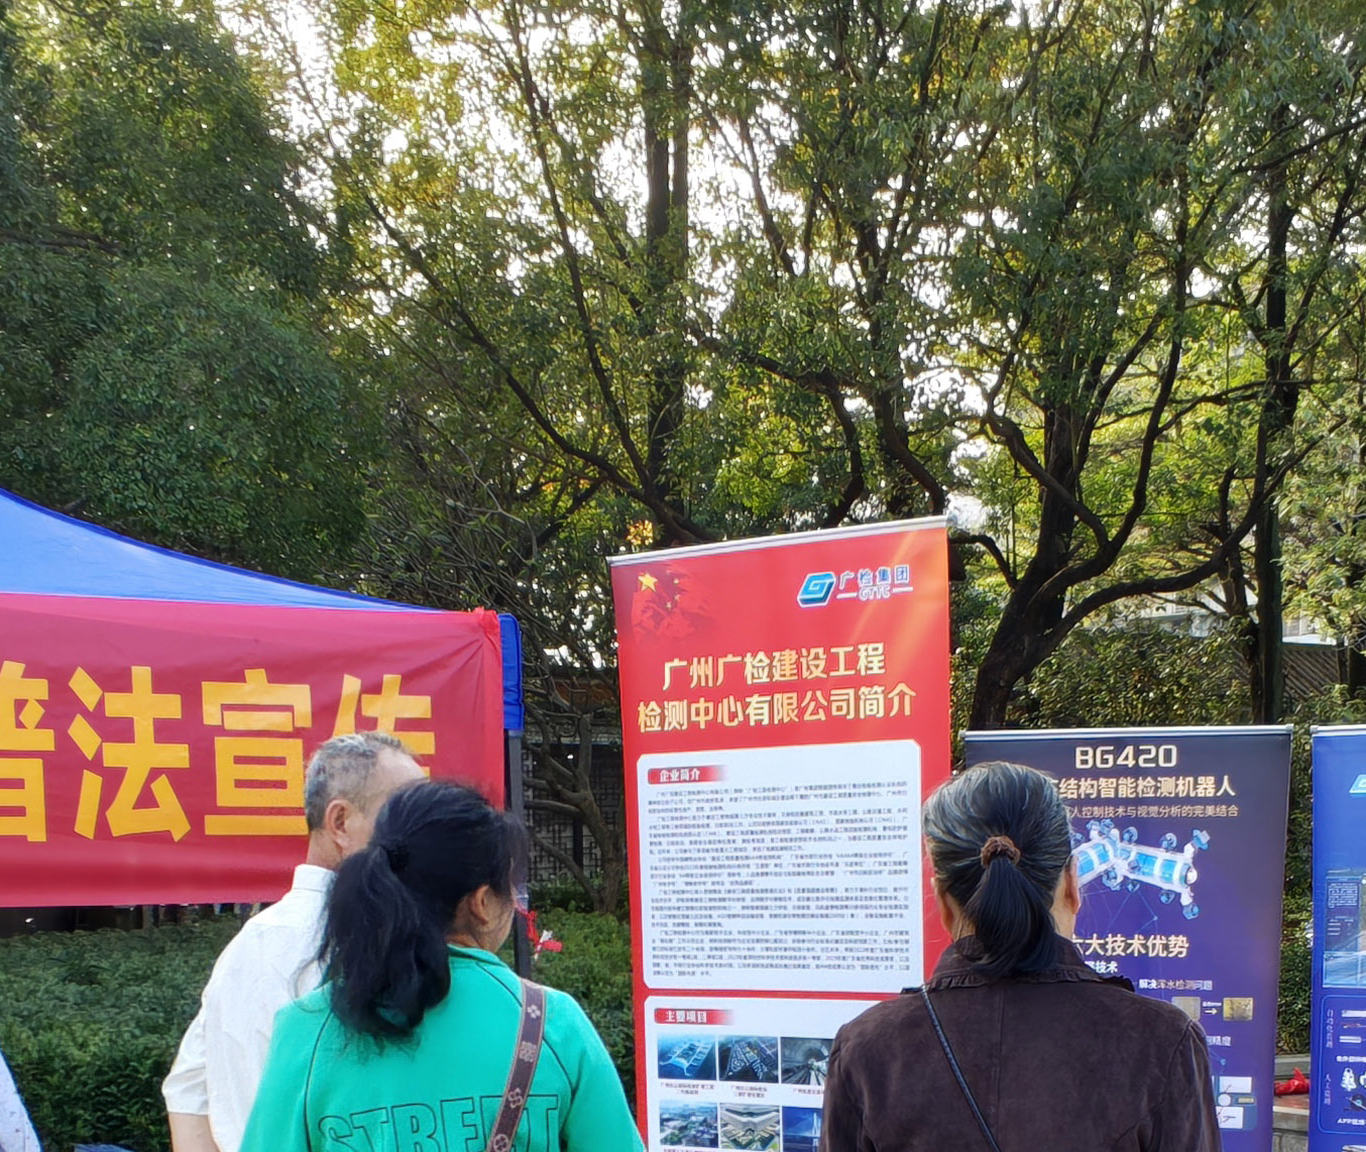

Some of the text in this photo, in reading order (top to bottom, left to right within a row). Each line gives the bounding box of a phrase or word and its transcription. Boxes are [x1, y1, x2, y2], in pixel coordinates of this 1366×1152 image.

[838, 564, 910, 590] 广检集团
[859, 585, 891, 601] GTTC
[662, 642, 886, 691] 广州广检建设工程
[638, 682, 917, 733] 检测中心有限公司简介
[1075, 744, 1178, 769] BG420
[659, 767, 701, 783] 企业简介
[1071, 934, 1189, 958] 六大技术优势
[664, 1009, 708, 1024] 主要项目
